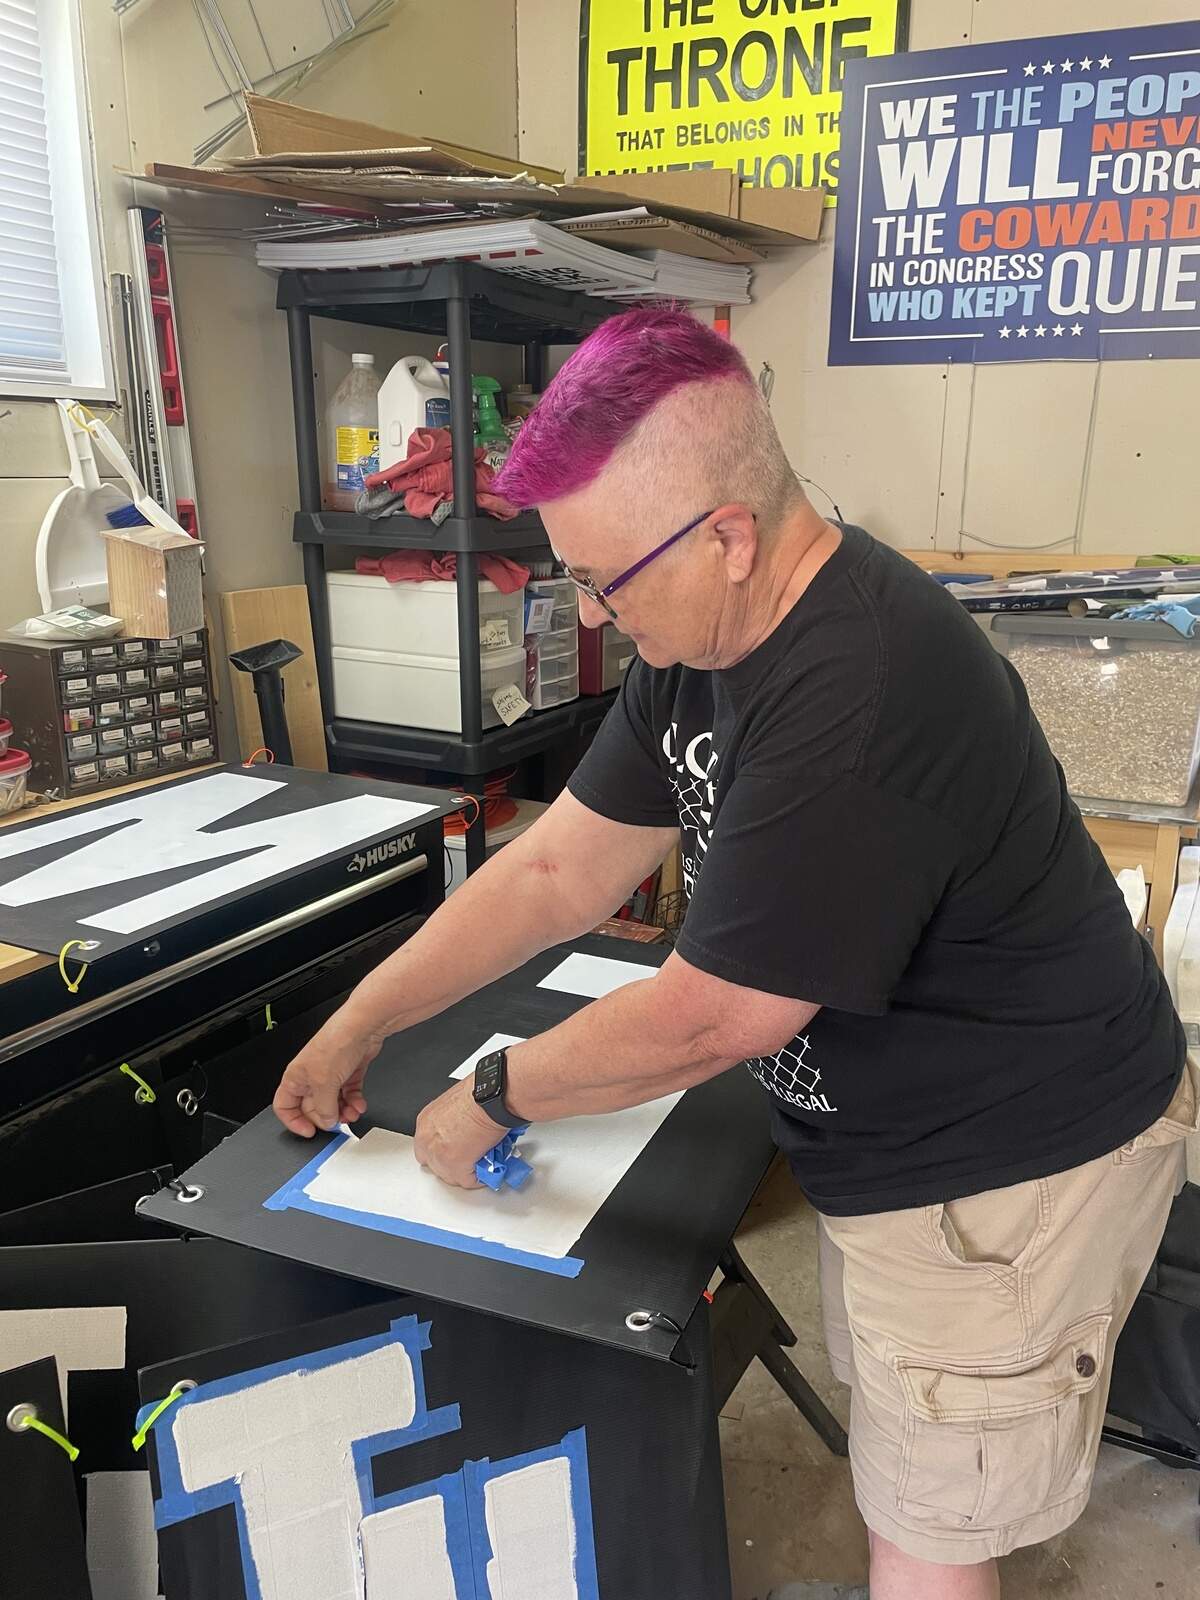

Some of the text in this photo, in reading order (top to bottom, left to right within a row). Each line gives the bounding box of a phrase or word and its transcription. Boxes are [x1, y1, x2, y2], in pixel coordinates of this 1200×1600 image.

[607, 17, 872, 116] THRONE
[879, 94, 958, 140] WE
[971, 85, 1044, 130] THE
[616, 128, 665, 152] THAT
[676, 116, 770, 148] BELONGS
[784, 114, 804, 137] IN
[1091, 114, 1200, 152] NEV
[877, 128, 1080, 212] WILL
[872, 212, 946, 257] THE
[869, 253, 1045, 288] IN CONGRESS
[868, 284, 1042, 323] WHO KEPT
[366, 832, 416, 867] HUSKY
